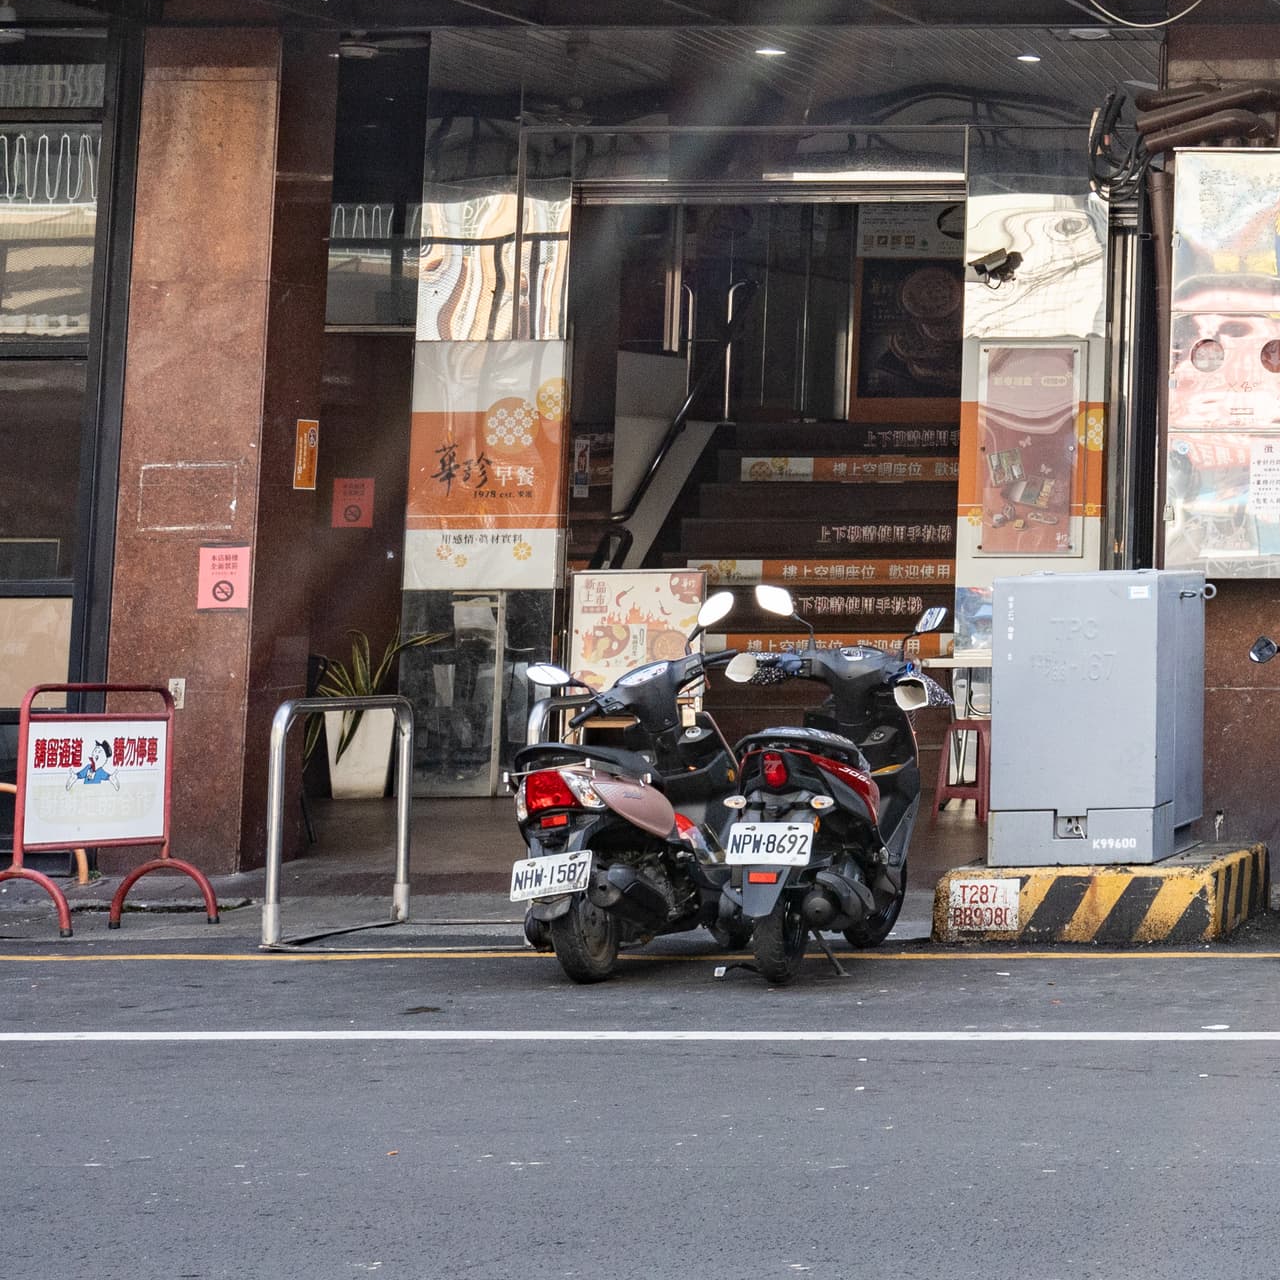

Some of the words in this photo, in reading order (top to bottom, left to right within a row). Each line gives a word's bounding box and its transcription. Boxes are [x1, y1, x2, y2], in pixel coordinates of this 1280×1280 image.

[782, 564, 876, 580] 樓上空調座位
[888, 564, 951, 580] 歡迎使用
[33, 736, 84, 769] 請留通道
[112, 736, 159, 768] 請勿停車
[1092, 837, 1137, 849] K99600
